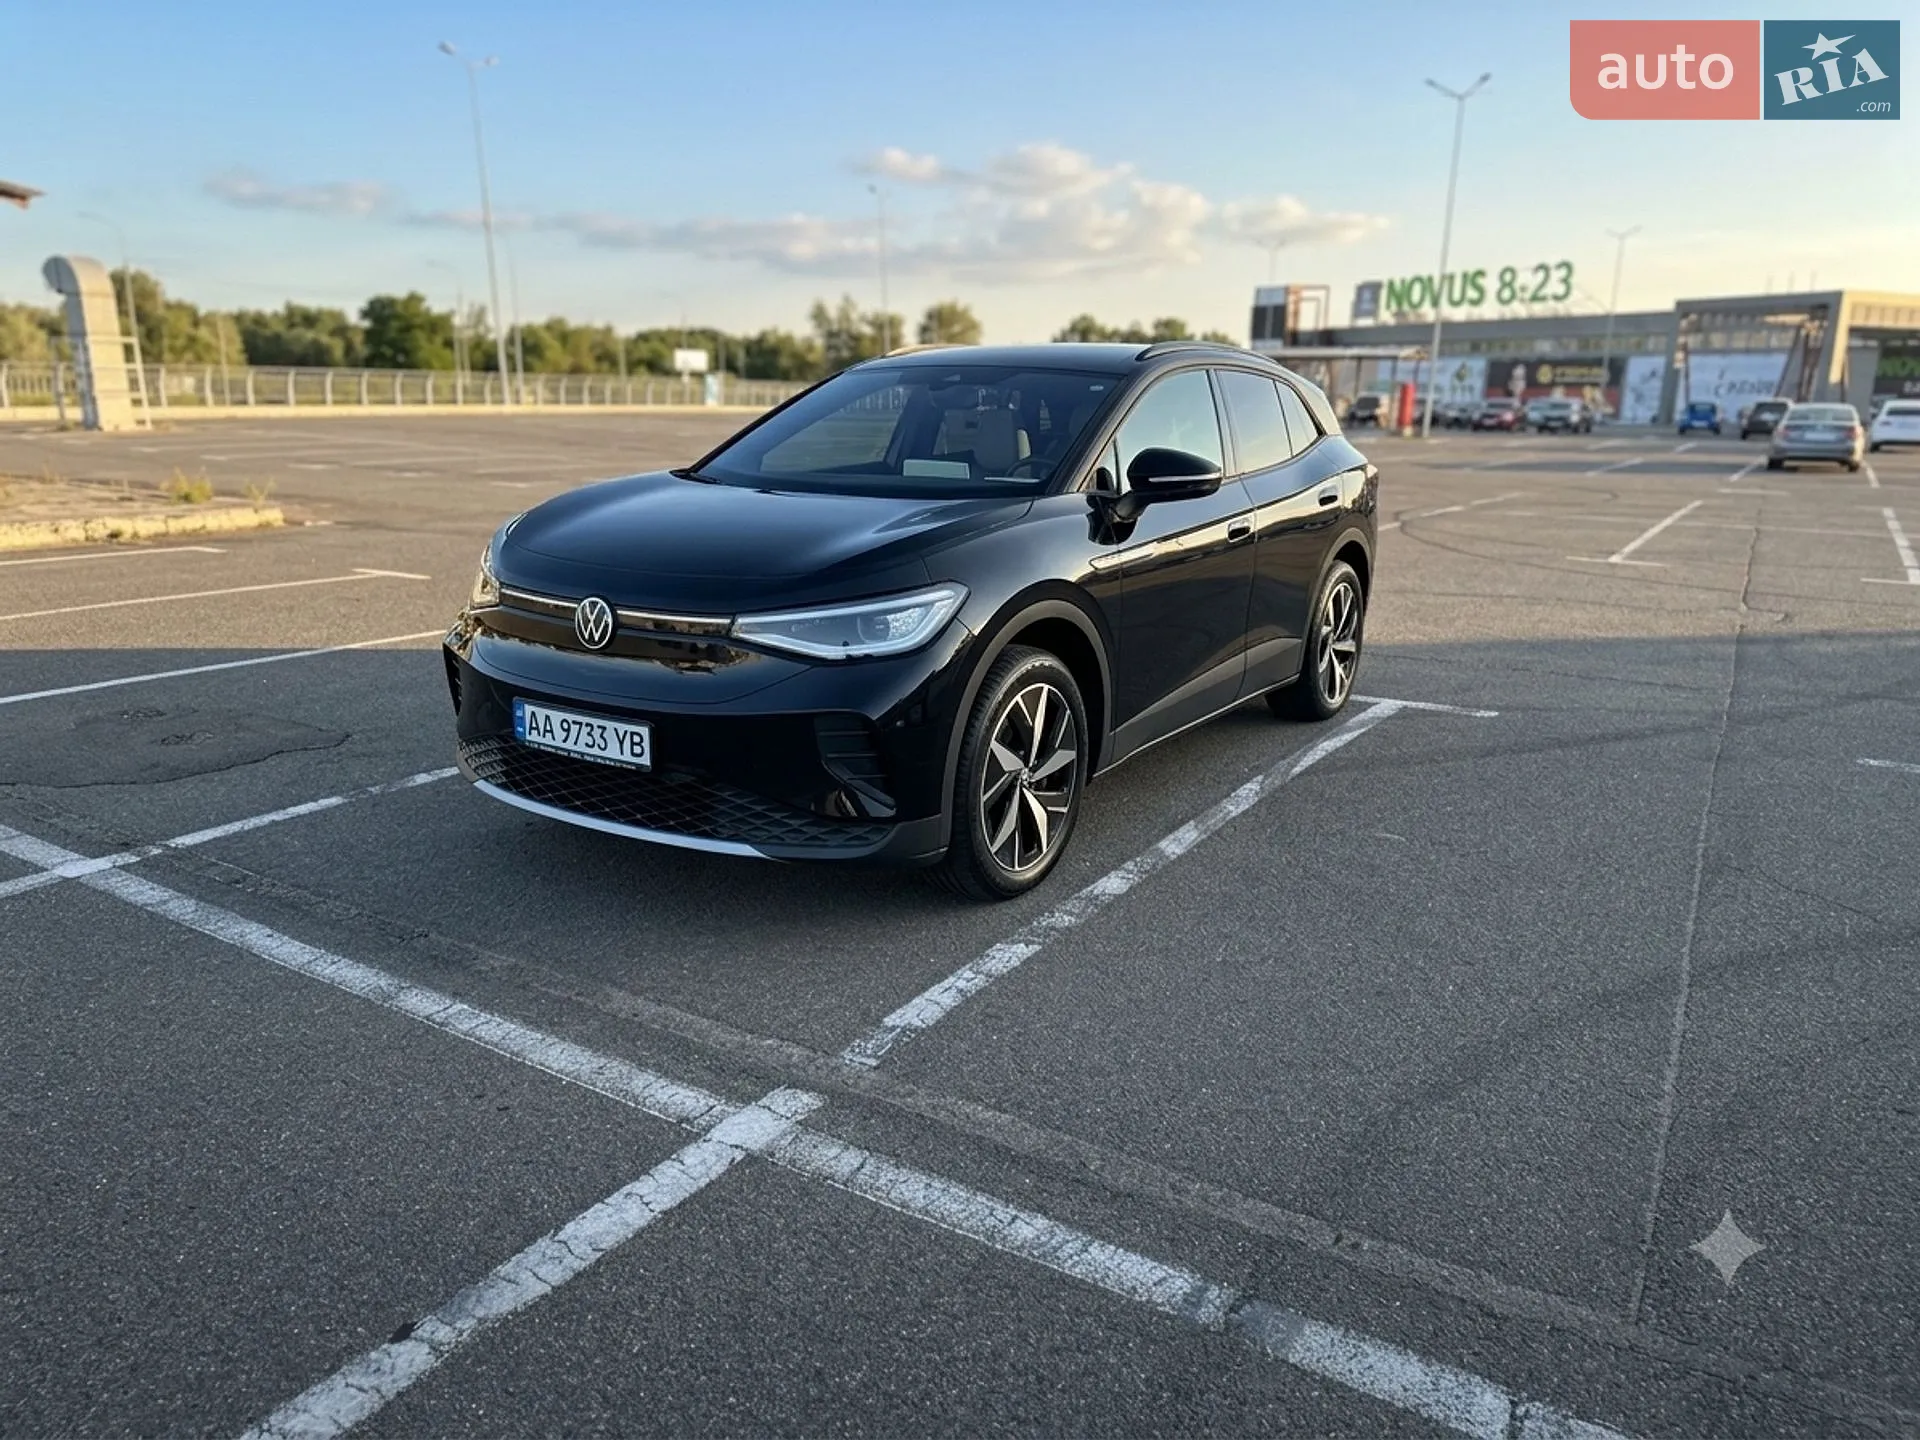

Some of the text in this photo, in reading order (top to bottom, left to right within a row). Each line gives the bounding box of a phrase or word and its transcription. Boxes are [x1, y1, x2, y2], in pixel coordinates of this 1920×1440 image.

[1386, 270, 1486, 310] NOVUS
[528, 710, 556, 741] AA
[560, 718, 608, 752] 9733
[614, 727, 645, 758] YB
